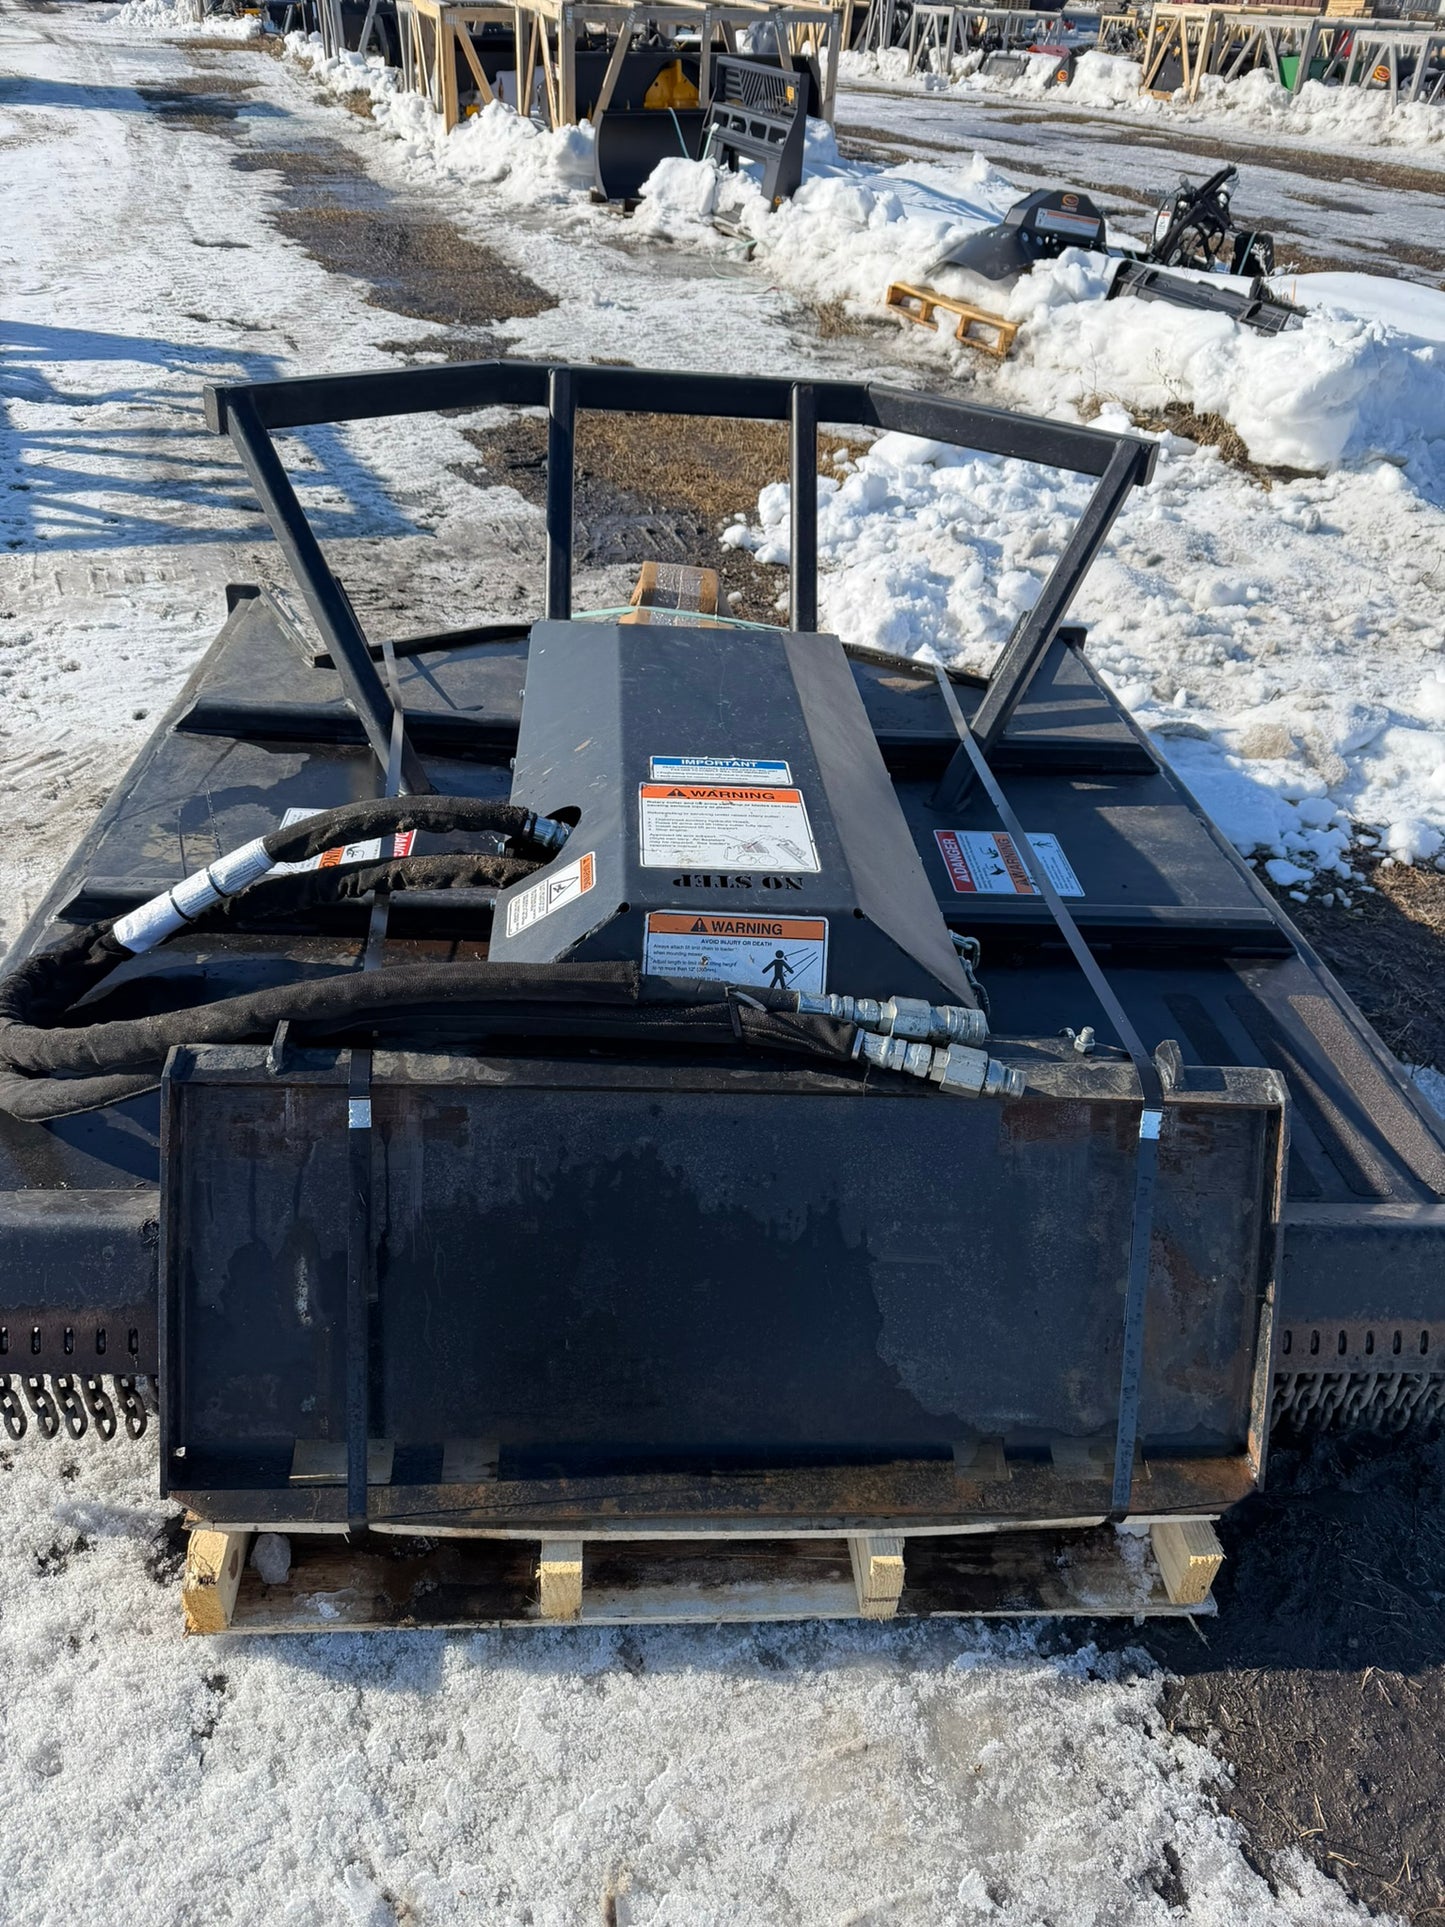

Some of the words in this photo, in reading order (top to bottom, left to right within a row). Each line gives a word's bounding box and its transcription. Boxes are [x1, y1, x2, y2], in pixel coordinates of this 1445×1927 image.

[681, 759, 758, 768] IMPORTANT
[690, 789, 775, 800] WARNING
[943, 838, 968, 874] DANGER
[1000, 838, 1028, 880] WARNING
[672, 874, 752, 889] STEP
[762, 876, 804, 890] NO
[711, 920, 783, 935] WARNING
